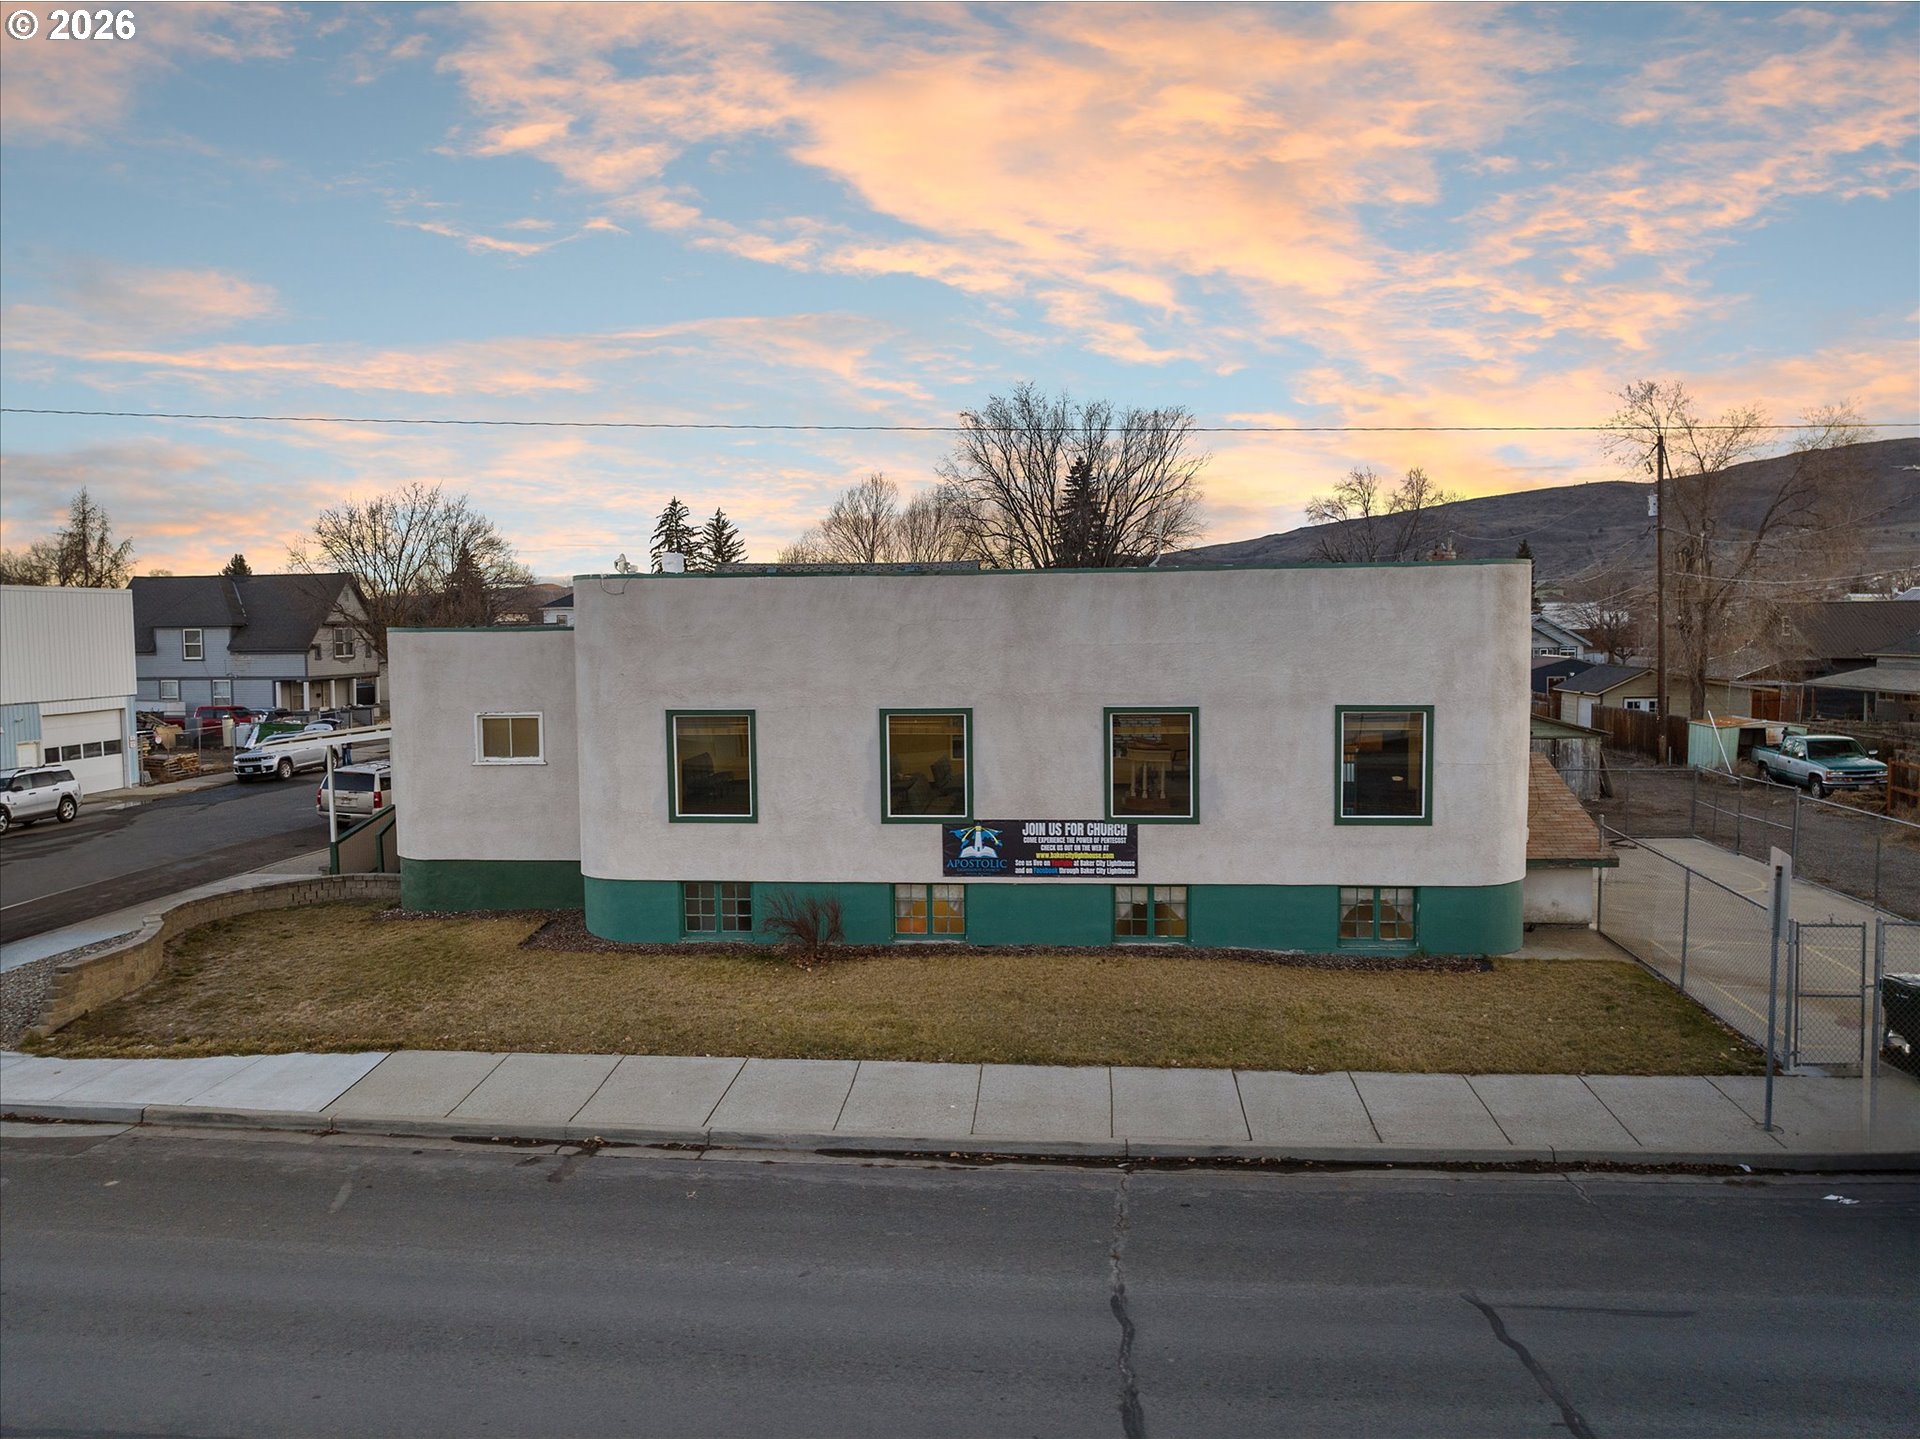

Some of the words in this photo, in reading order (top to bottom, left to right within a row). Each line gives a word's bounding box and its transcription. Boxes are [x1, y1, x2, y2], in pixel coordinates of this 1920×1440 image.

[1022, 822, 1046, 836] JOIN
[1048, 822, 1062, 836] US
[1064, 822, 1084, 836] FOR
[1087, 822, 1128, 836] CHURCH
[946, 859, 1008, 868] APOSTOLIC
